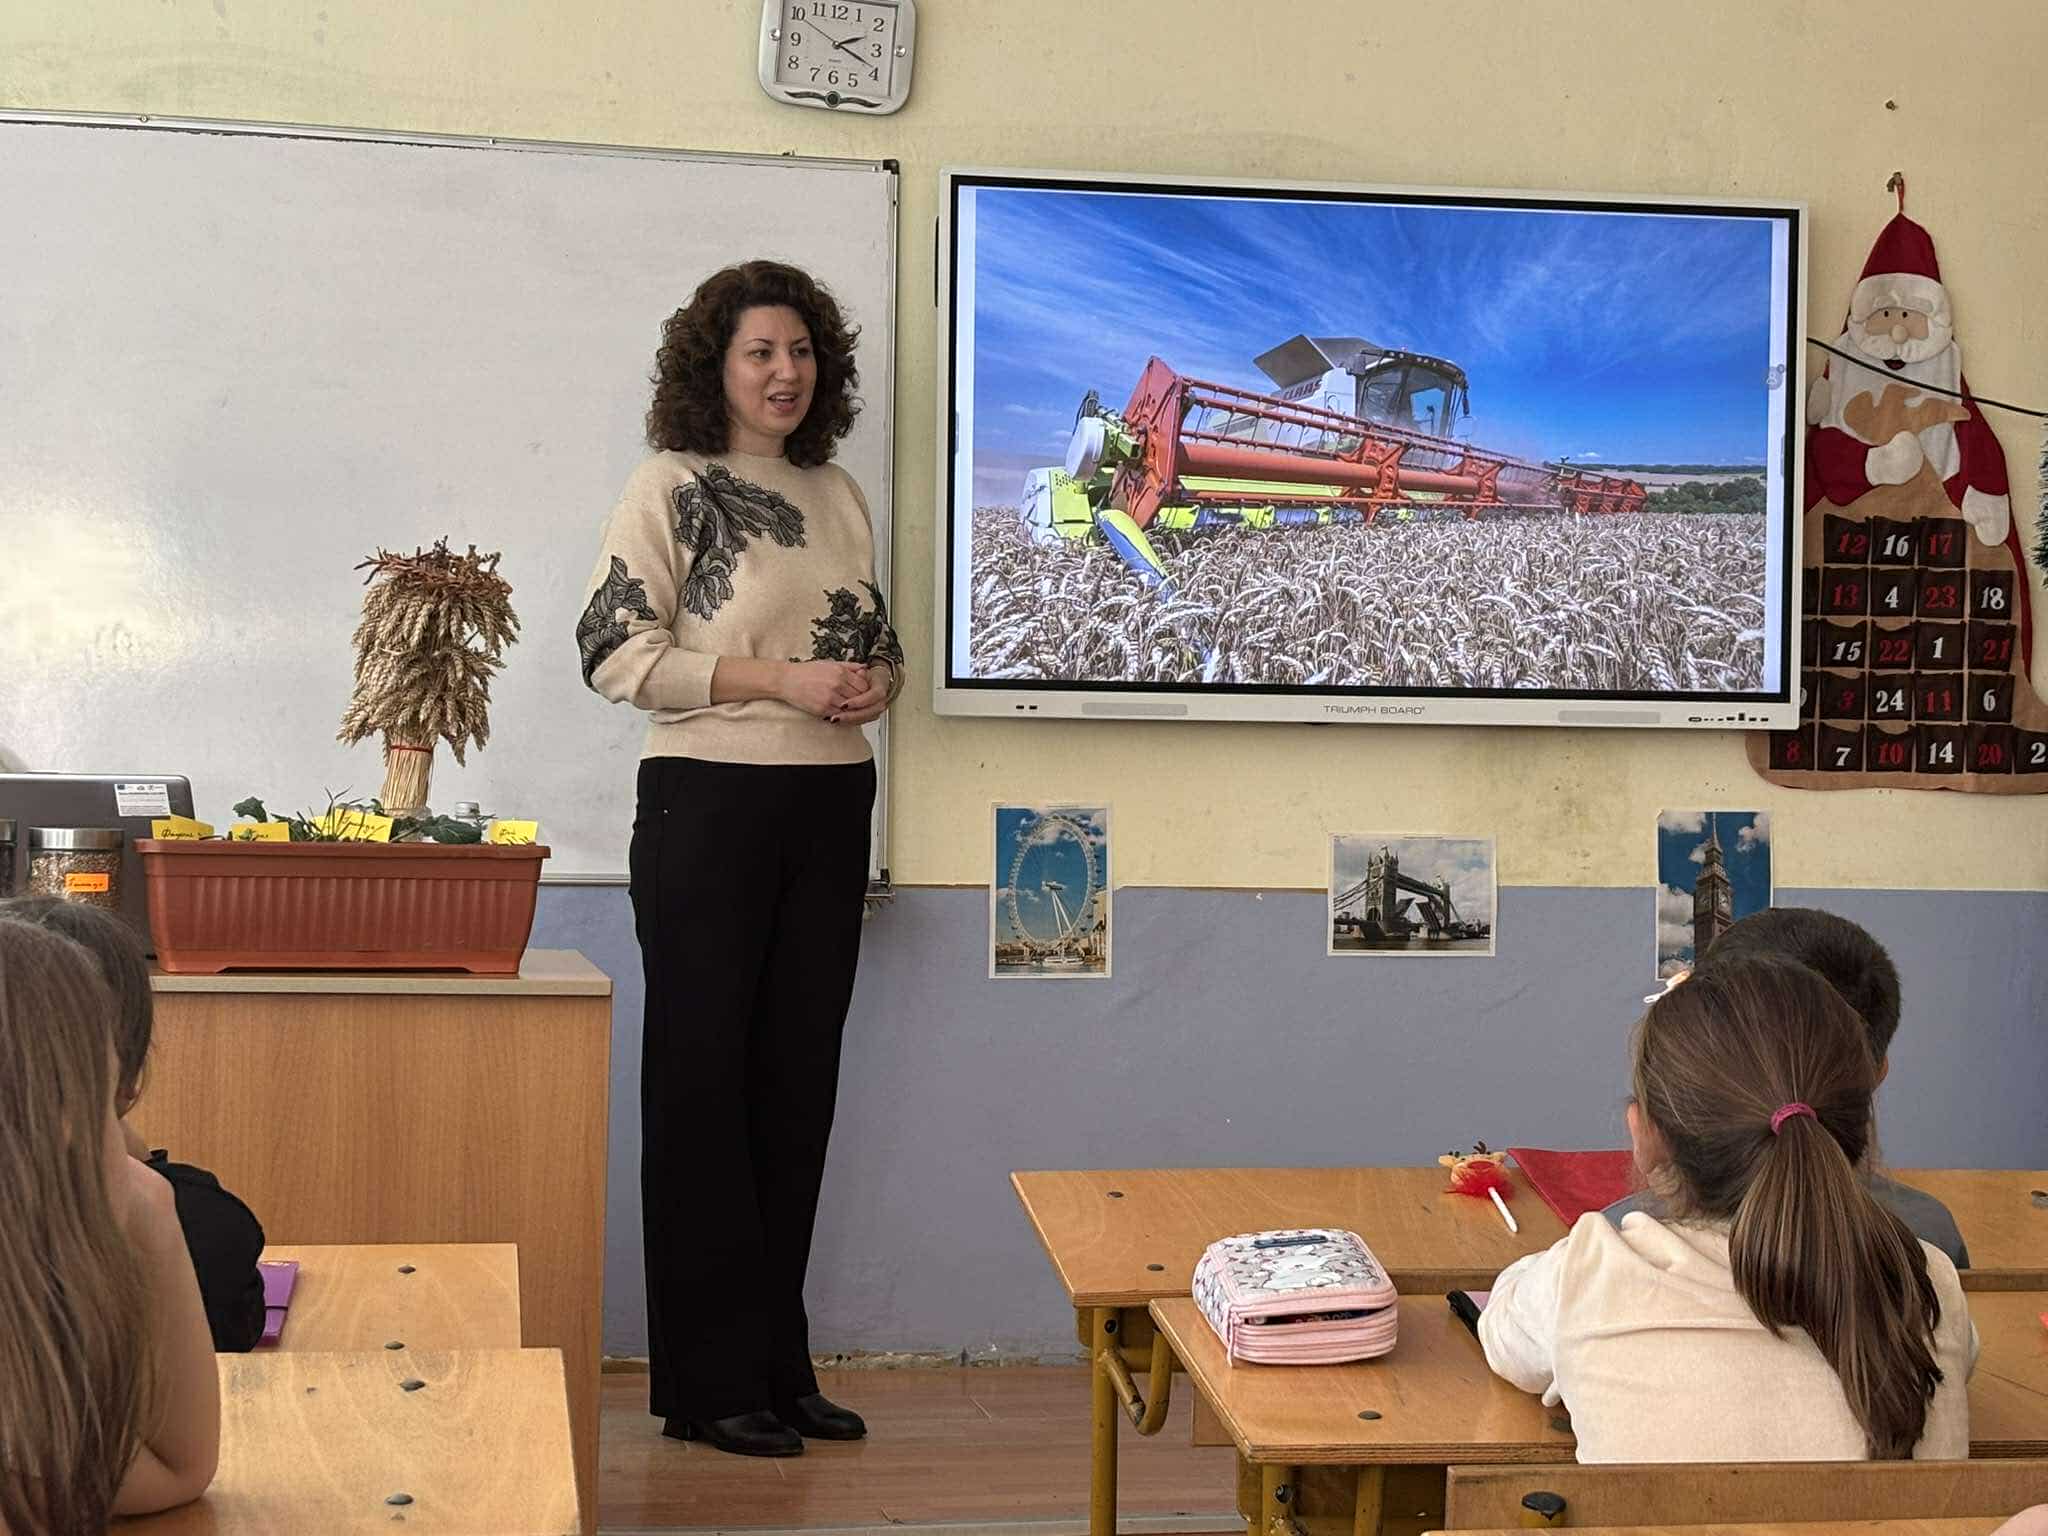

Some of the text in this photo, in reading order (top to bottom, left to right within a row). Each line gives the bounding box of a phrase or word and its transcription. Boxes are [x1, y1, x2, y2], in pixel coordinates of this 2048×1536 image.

[791, 6, 806, 21] 10
[812, 2, 827, 17] 11
[831, 5, 848, 20] 12
[856, 8, 863, 22] 1
[873, 18, 884, 32] 2
[790, 32, 801, 46] 9
[871, 43, 882, 58] 3
[788, 55, 799, 70] 8
[809, 67, 821, 82] 7
[828, 70, 839, 85] 6
[848, 73, 858, 88] 5
[868, 67, 879, 81] 4
[1838, 530, 1868, 555] 12
[1883, 533, 1911, 557] 16
[1928, 531, 1953, 557] 17
[1833, 583, 1859, 608] 13
[1884, 586, 1899, 608] 4
[1925, 584, 1957, 608] 23
[1981, 586, 2004, 610] 18
[1832, 641, 1863, 661] 15
[1879, 639, 1909, 662] 22
[1932, 637, 1944, 659] 1
[1983, 639, 2010, 662] 21
[1323, 704, 1377, 715] TRIUMPH
[1876, 689, 1905, 713] 24
[1926, 689, 1952, 713] 11
[1983, 689, 1996, 712] 6
[1836, 747, 1852, 766] 7
[1878, 743, 1905, 766] 10
[1929, 741, 1954, 764] 14
[2030, 742, 2046, 764] 2
